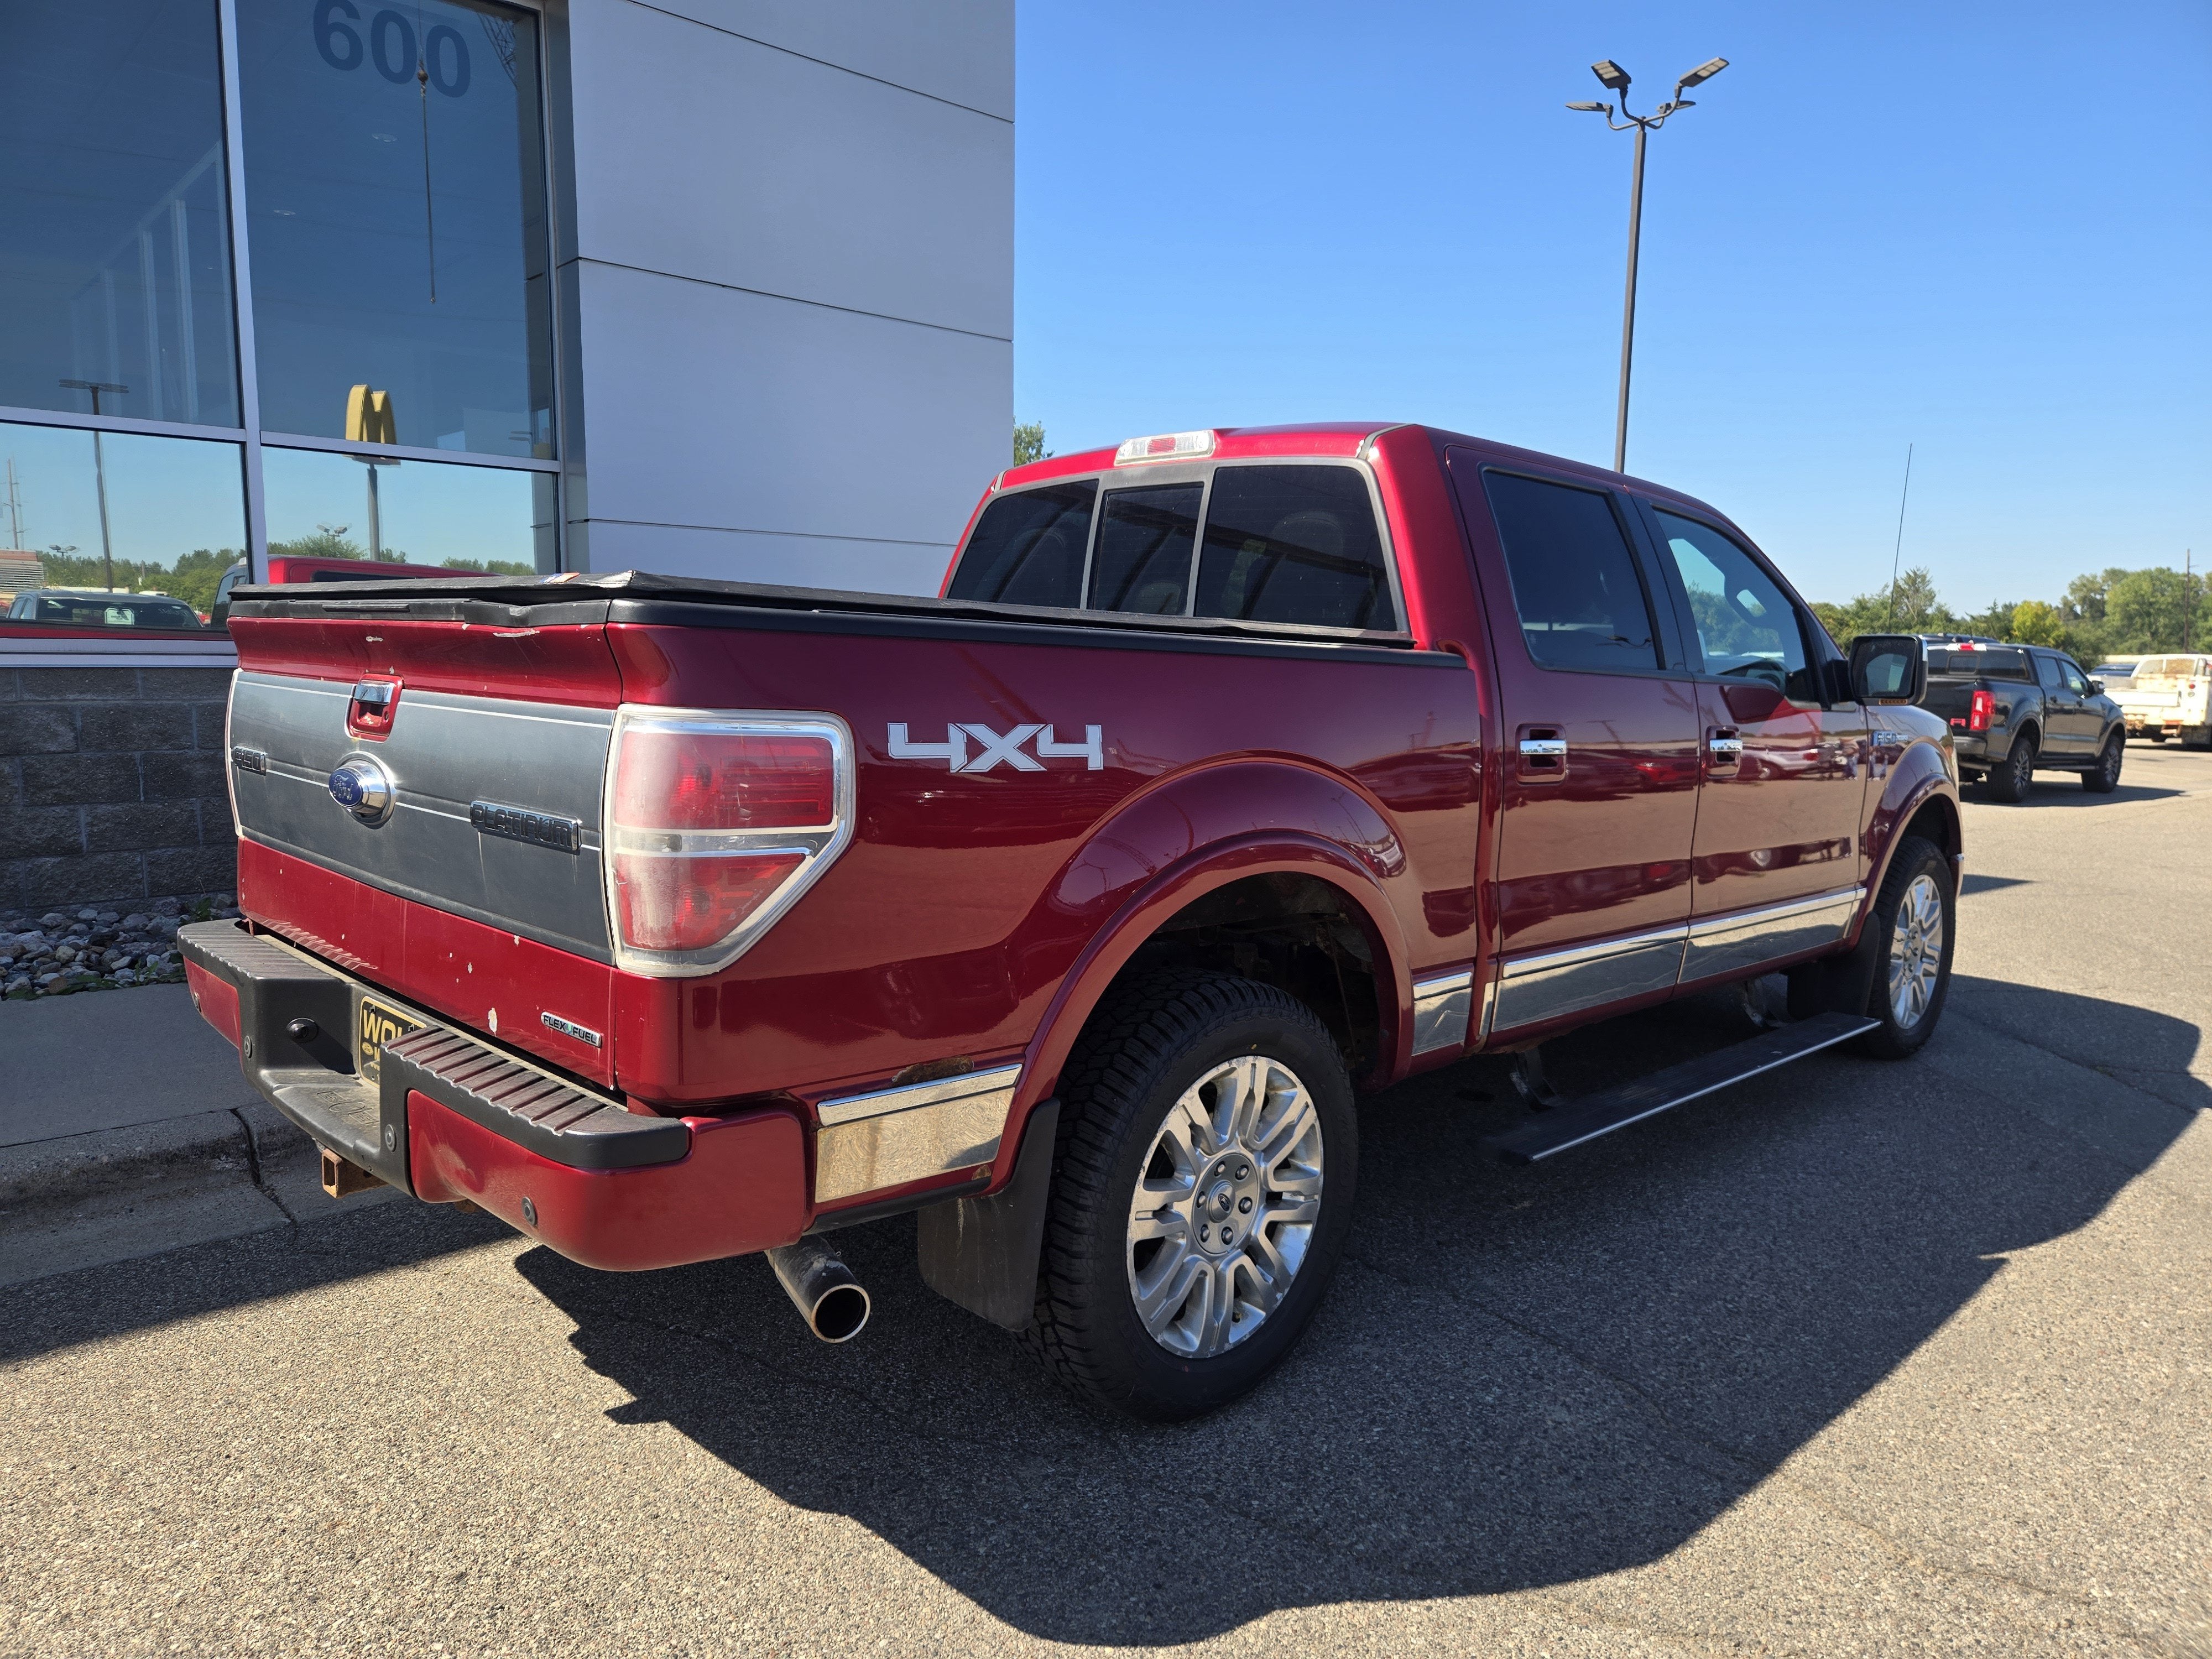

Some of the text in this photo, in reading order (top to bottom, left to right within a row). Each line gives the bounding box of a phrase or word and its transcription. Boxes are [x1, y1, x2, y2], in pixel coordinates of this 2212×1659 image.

[313, 0, 470, 98] 600
[333, 774, 353, 801] Ford
[471, 804, 572, 848] PLATINUM
[544, 1015, 596, 1044] FLEX FUEL
